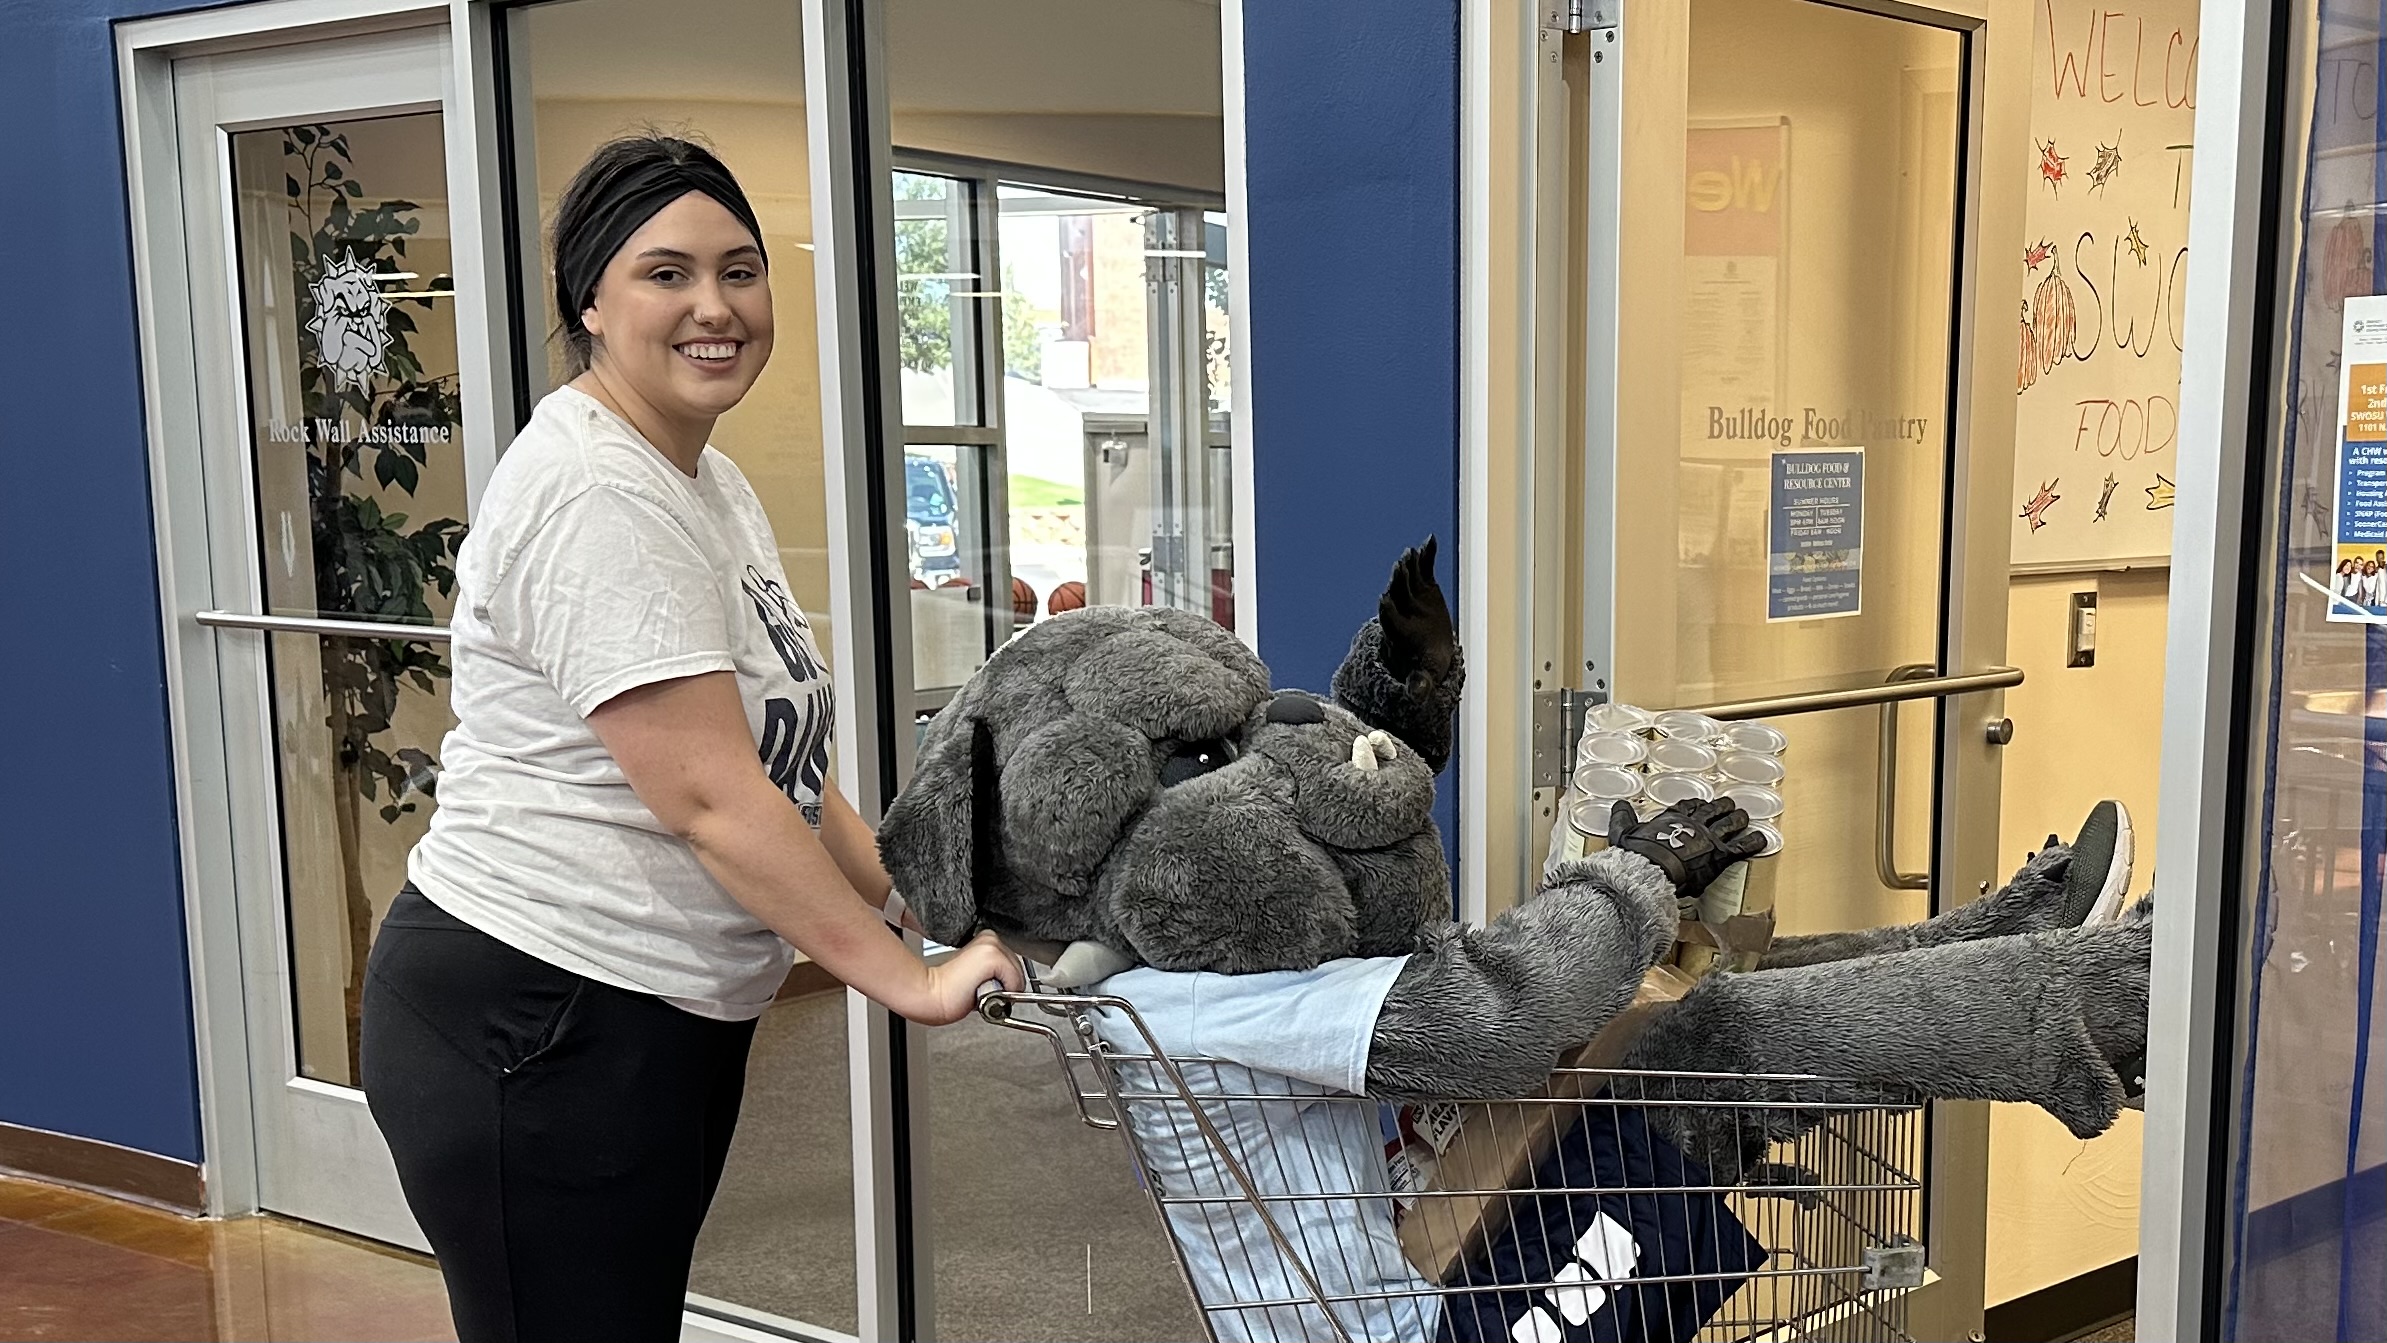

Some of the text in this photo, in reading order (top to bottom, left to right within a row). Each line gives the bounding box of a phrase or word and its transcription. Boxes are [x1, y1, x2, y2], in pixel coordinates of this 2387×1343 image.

[2361, 384, 2378, 395] 1st
[268, 418, 450, 444] Rock Wall Assistance
[1708, 406, 1794, 447] Bulldog
[1802, 407, 1853, 440] Food
[2075, 395, 2177, 461] FOOD
[2348, 456, 2369, 465] with
[1786, 463, 1821, 475] BULLDOG
[1822, 462, 1842, 474] FOOD
[2357, 470, 2386, 478] Program
[1784, 477, 1851, 490] RESOURCE CENTER
[1432, 1103, 1465, 1141] FLAVO
